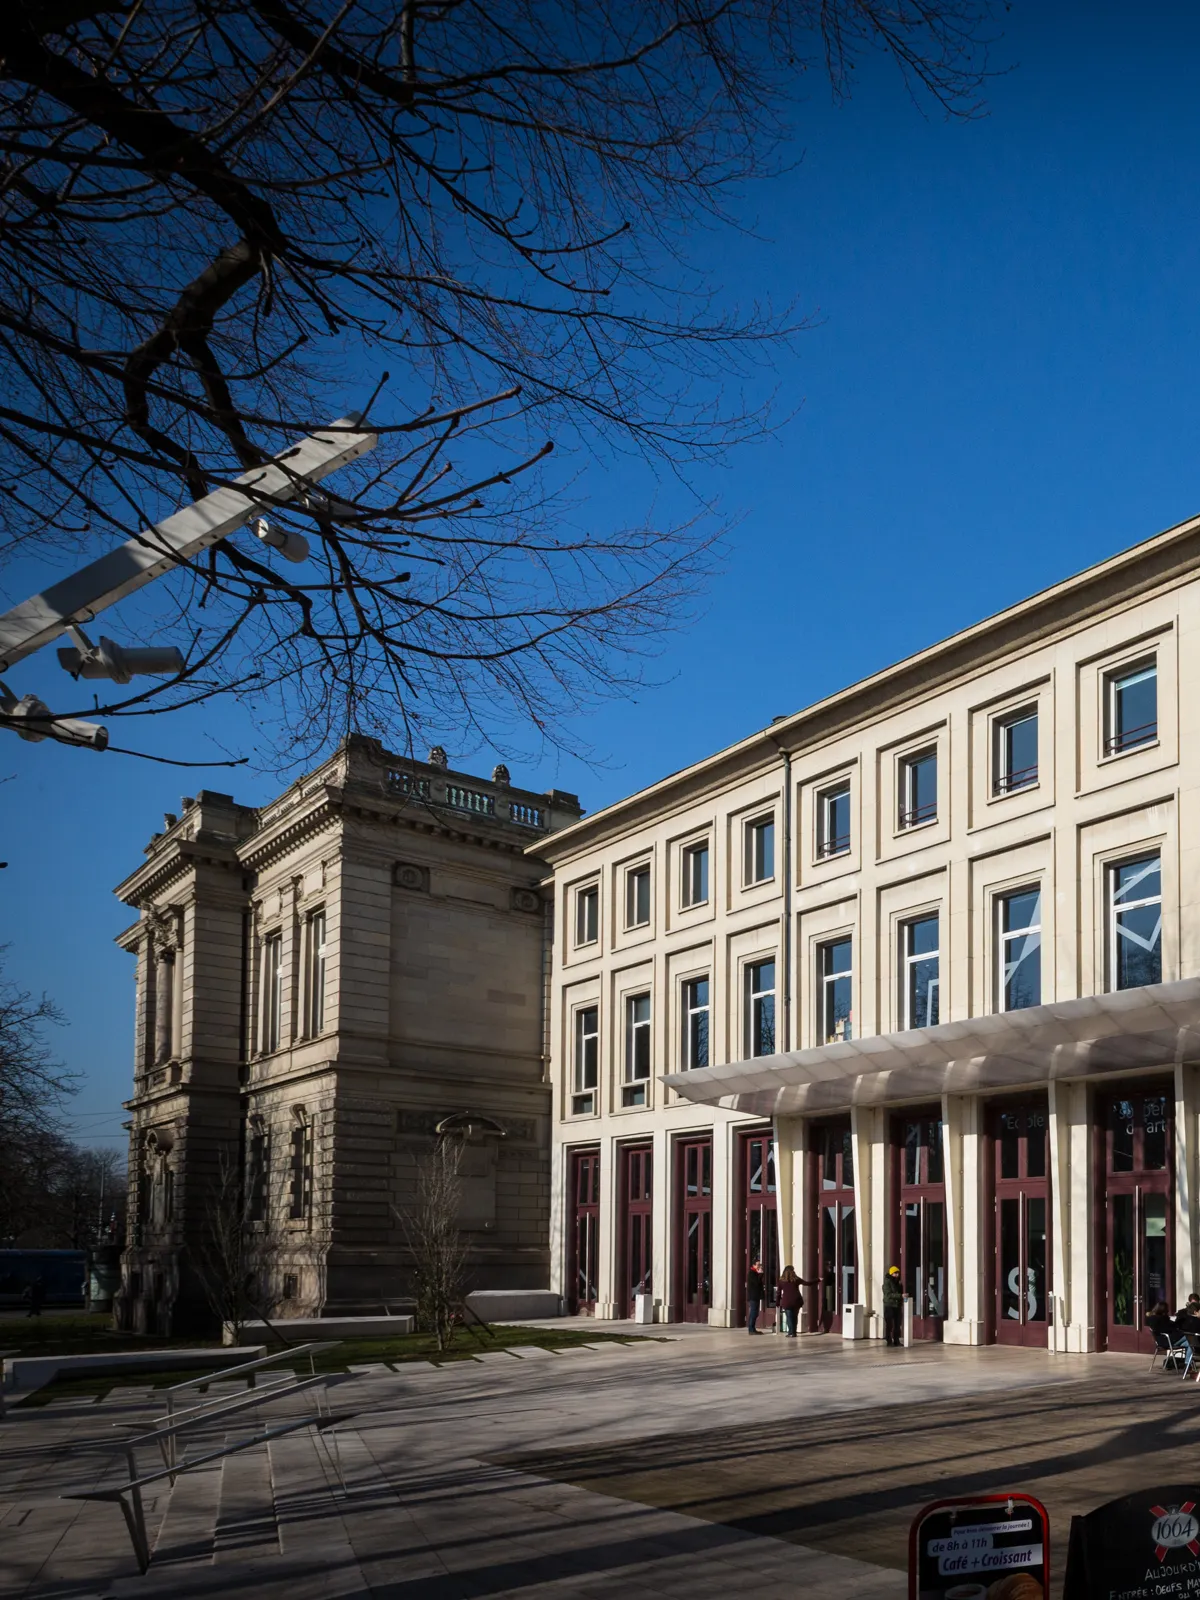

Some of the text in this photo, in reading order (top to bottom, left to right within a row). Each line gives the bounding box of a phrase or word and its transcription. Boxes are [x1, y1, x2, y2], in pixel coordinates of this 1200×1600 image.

[1007, 1266, 1038, 1320] S
[1156, 1517, 1195, 1540] 1664
[932, 1538, 988, 1553] de 8h à 11h
[943, 1549, 1033, 1571] Café + Croissant
